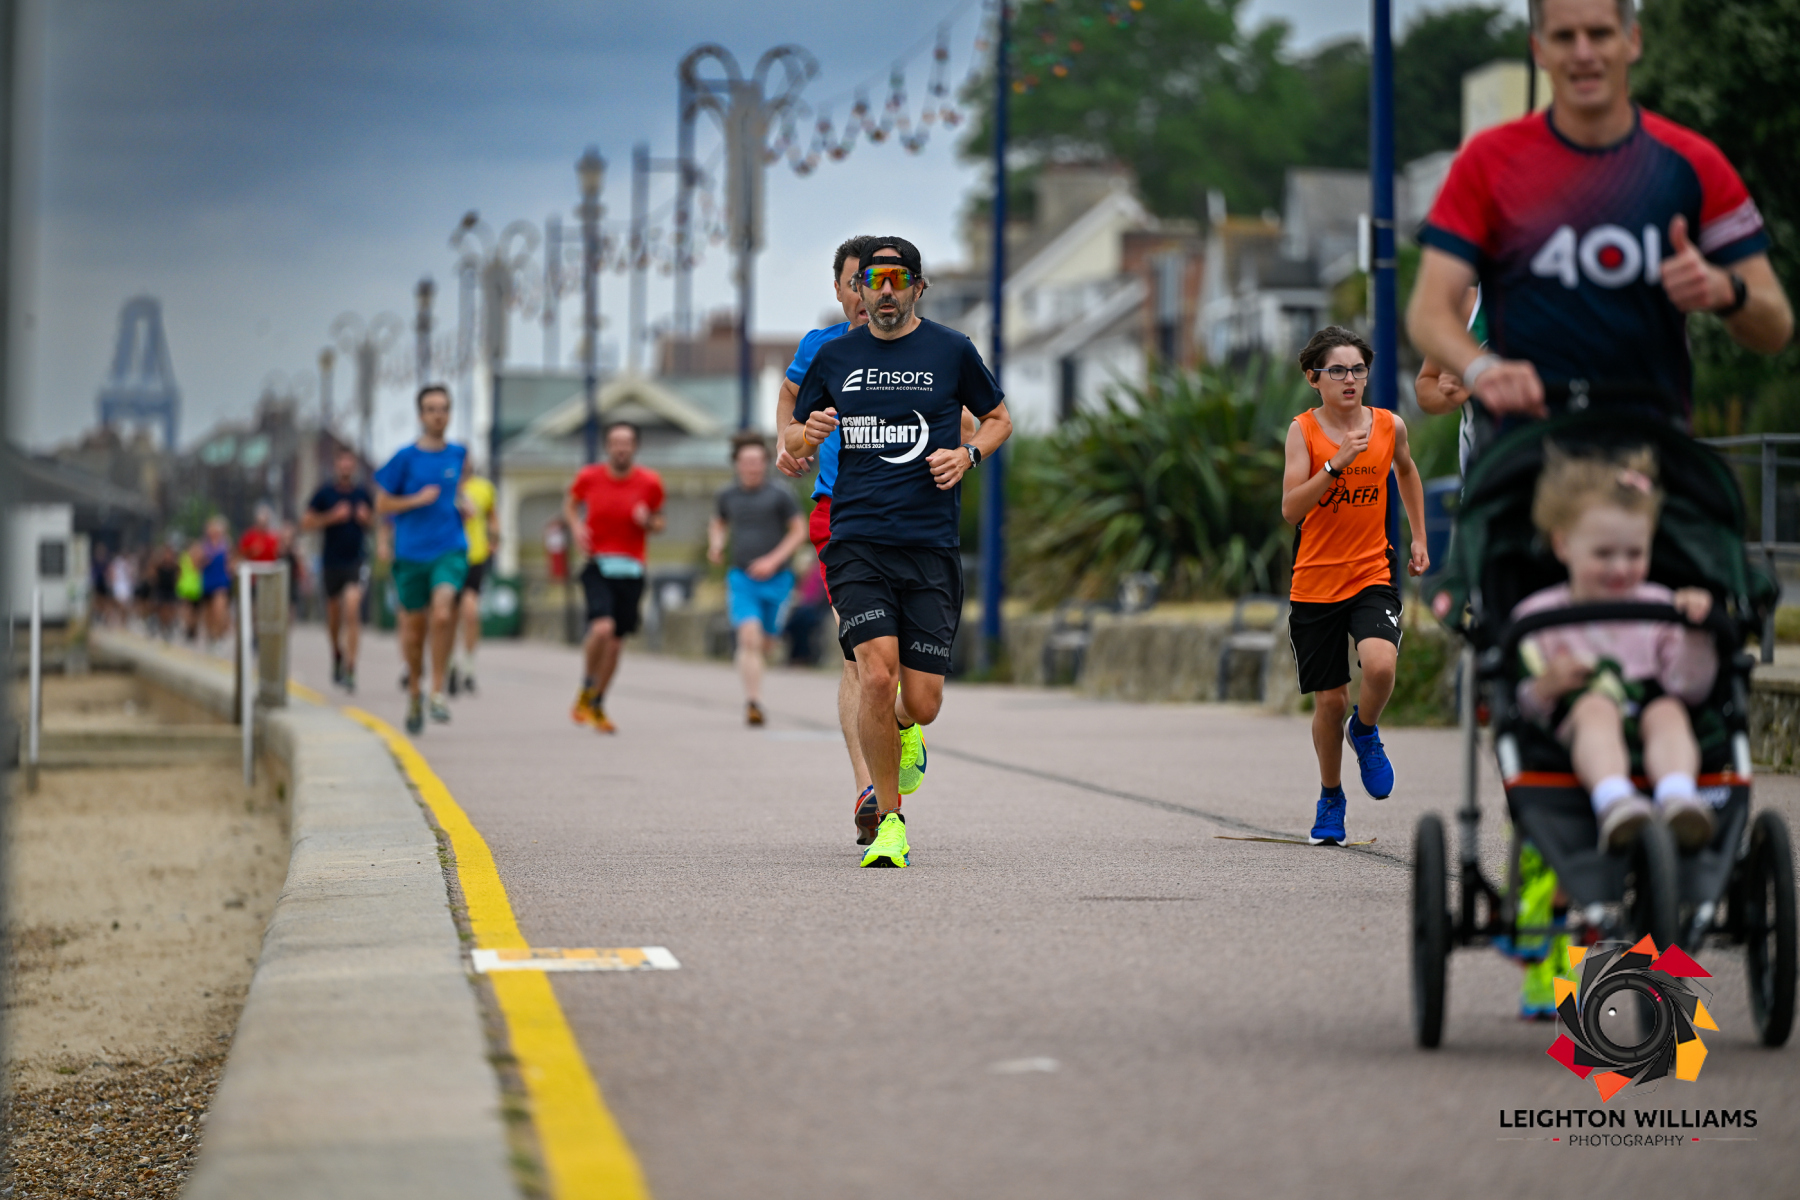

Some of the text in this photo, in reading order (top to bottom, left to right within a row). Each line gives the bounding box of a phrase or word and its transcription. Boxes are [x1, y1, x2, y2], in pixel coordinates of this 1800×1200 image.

[866, 368, 934, 385] Ensors
[841, 416, 877, 427] IPSWICH
[842, 425, 919, 444] TWILIGHT
[1341, 465, 1377, 475] EDERIC
